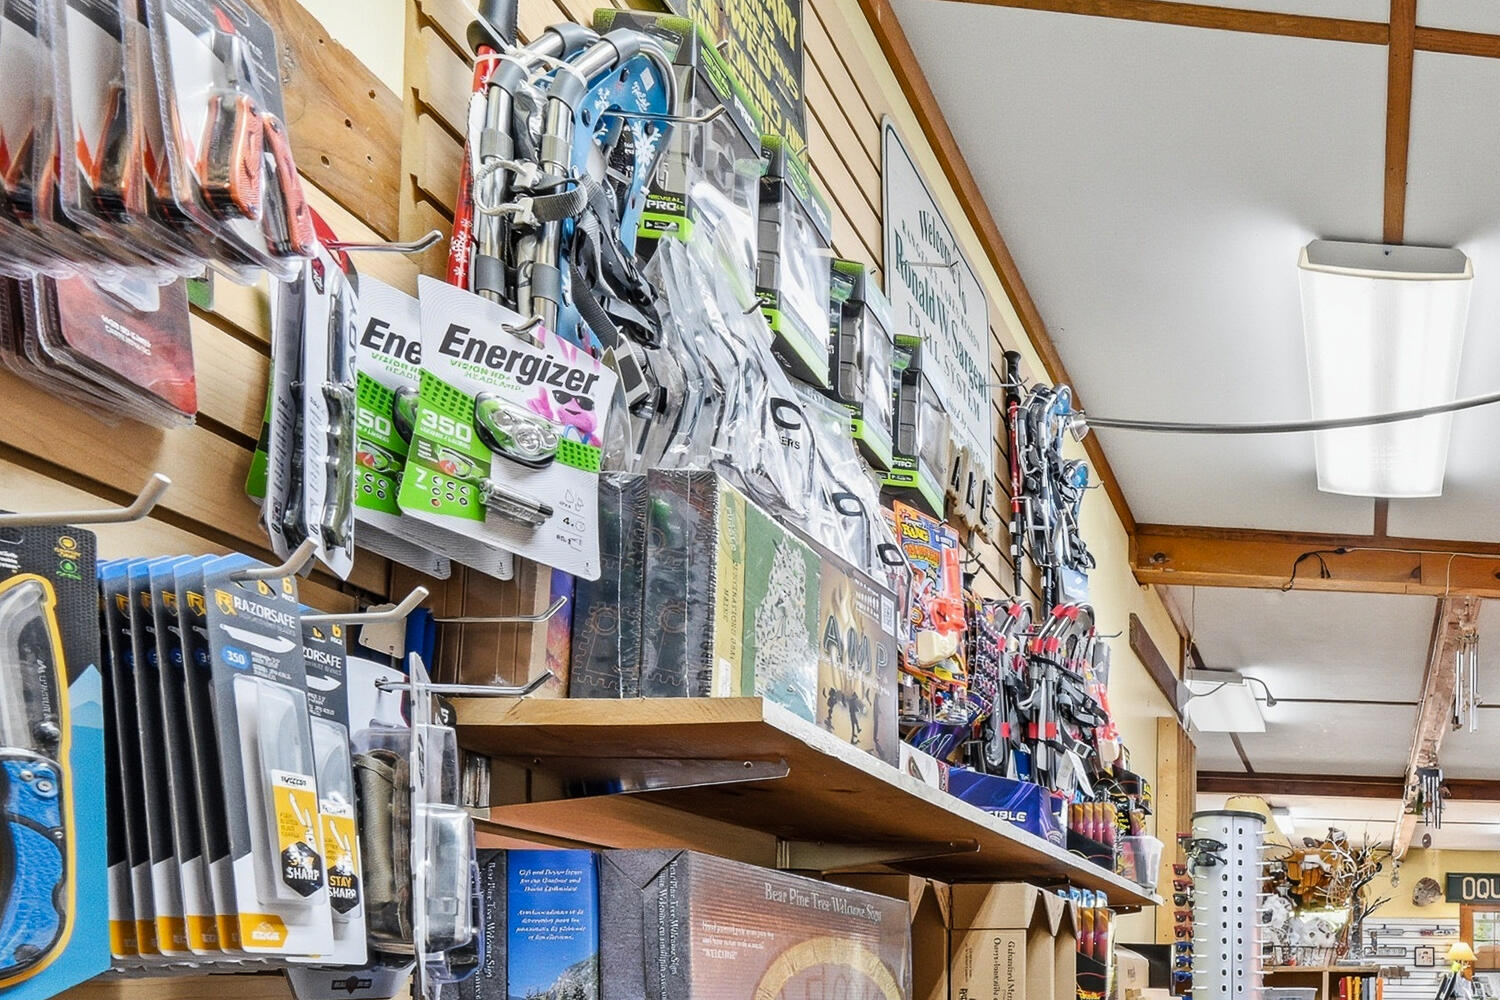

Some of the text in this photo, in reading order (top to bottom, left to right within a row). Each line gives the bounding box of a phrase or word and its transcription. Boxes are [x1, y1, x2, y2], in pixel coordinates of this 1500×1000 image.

[438, 323, 600, 395] Energizer
[356, 408, 392, 432] 50
[421, 408, 473, 443] 350
[233, 595, 296, 630] RAZORSAFE
[302, 646, 343, 669] ZORSAFE
[329, 875, 352, 887] STAY
[764, 882, 788, 903] Bear
[789, 887, 811, 908] Pine
